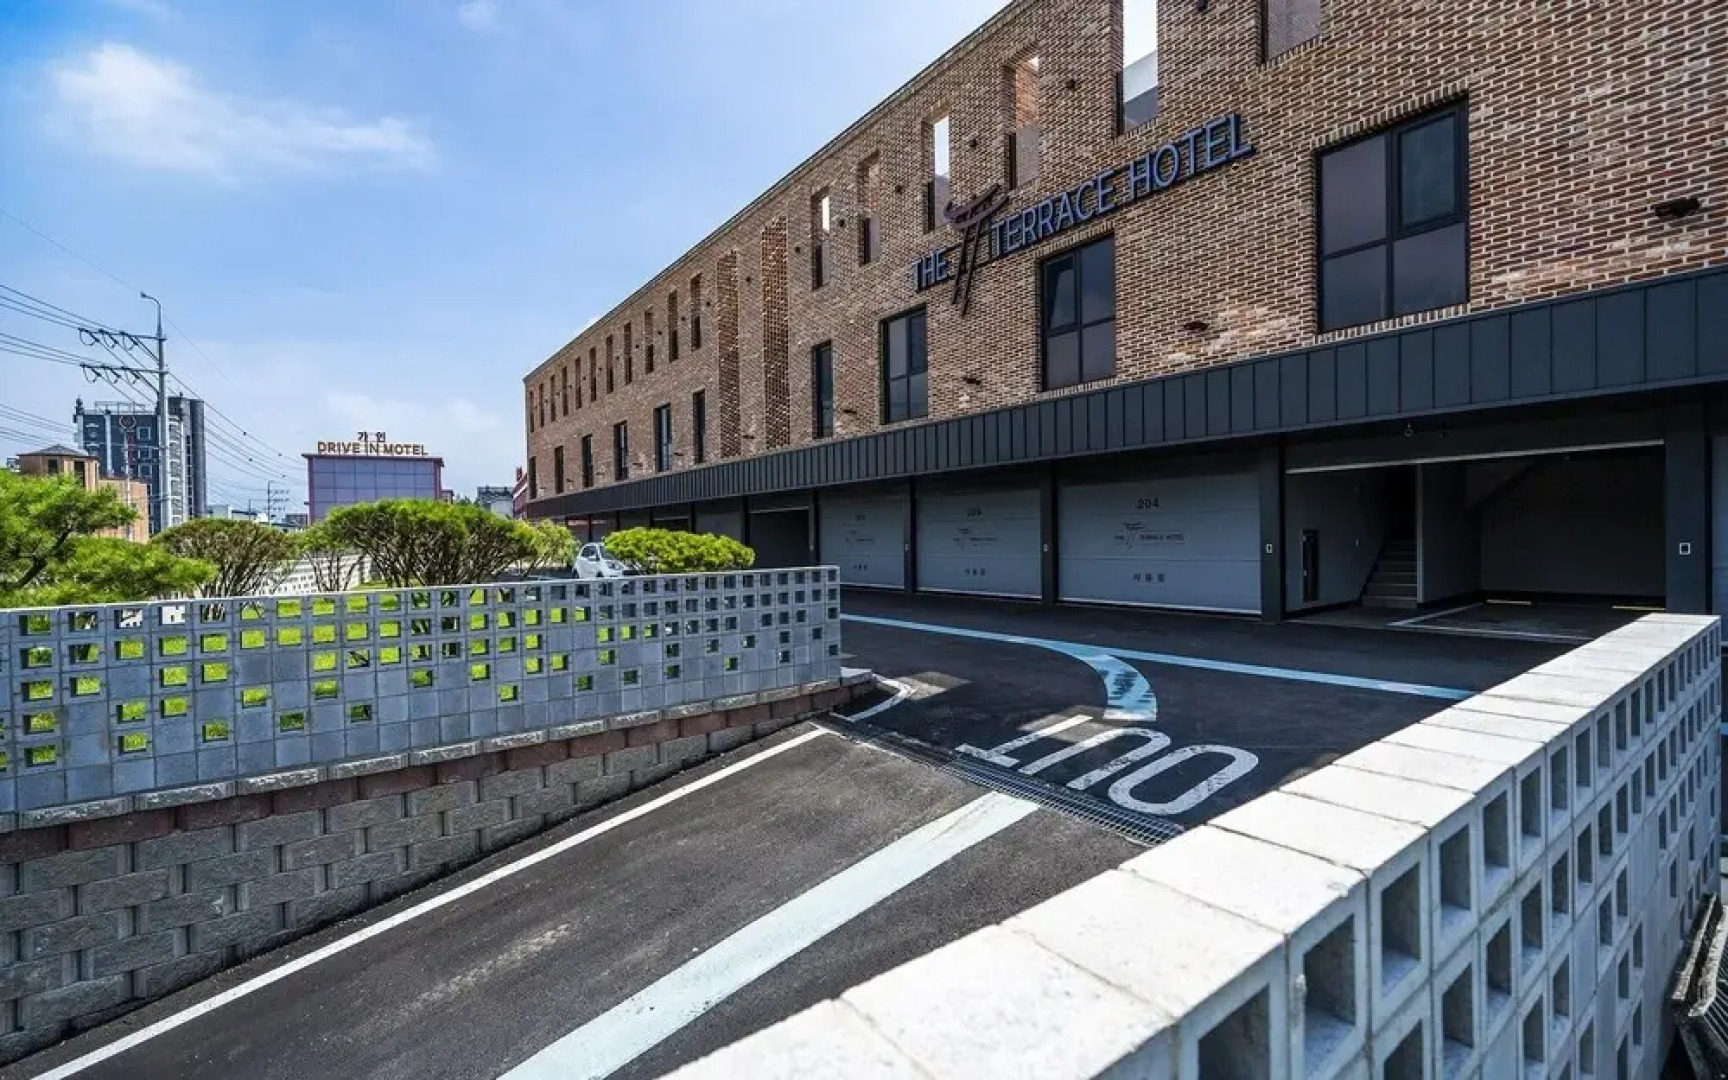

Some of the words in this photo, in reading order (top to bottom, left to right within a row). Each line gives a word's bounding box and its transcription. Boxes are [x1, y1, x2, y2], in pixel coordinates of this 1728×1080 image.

[911, 248, 951, 291] THE
[989, 169, 1118, 259] TERRACE
[1124, 112, 1256, 203] HOTEL
[317, 441, 360, 454] DRIVE
[364, 443, 379, 455] IN
[382, 443, 428, 456] MOTEL
[1136, 498, 1159, 509] 204
[954, 714, 1259, 815] OUT
